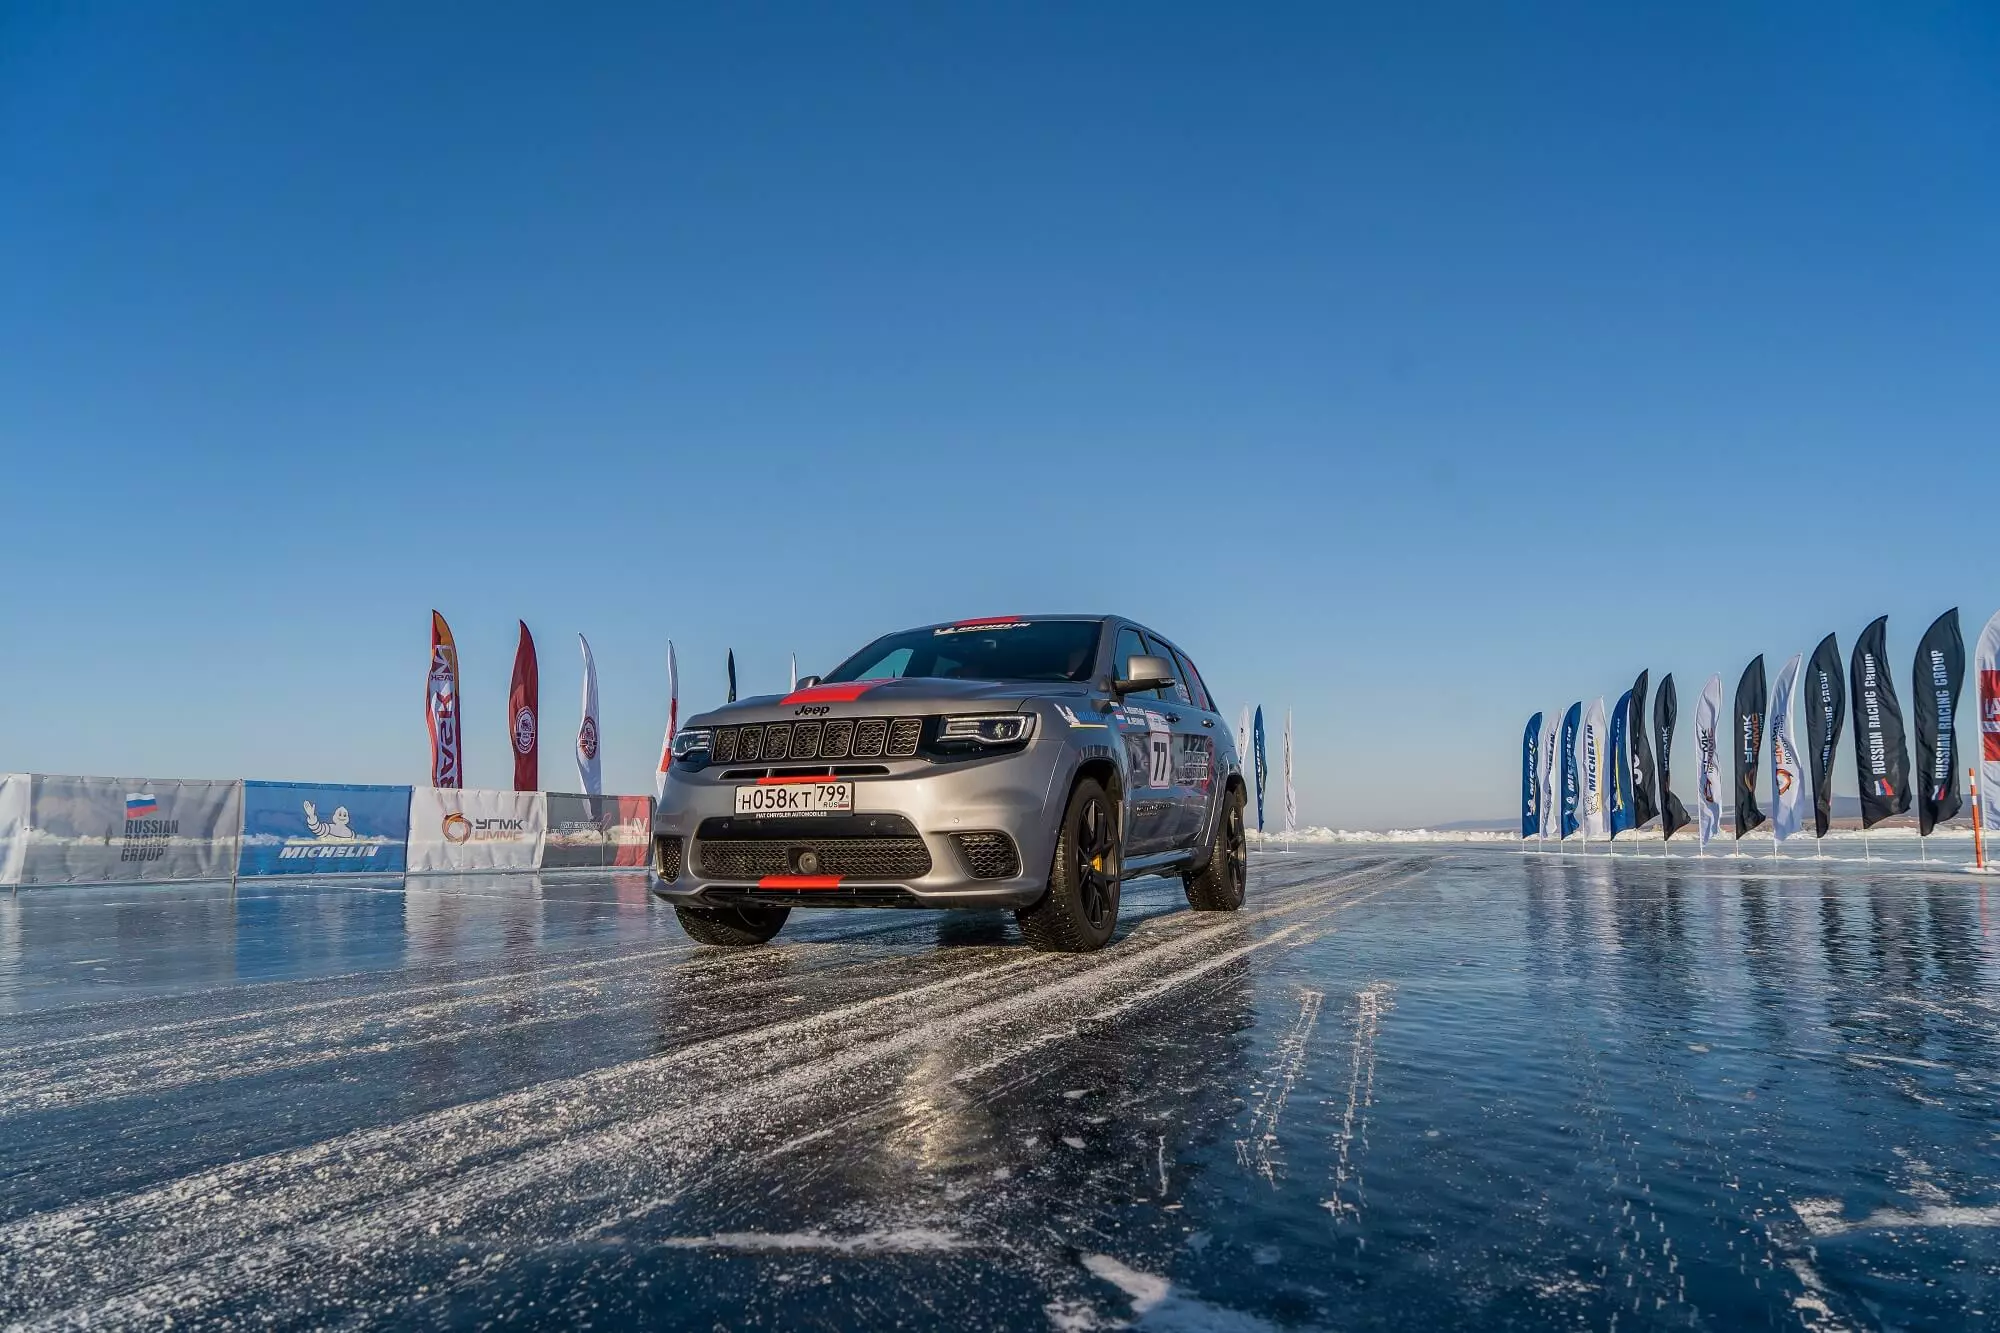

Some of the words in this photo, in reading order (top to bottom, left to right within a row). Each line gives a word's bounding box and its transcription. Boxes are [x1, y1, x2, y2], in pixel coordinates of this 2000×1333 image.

[1930, 649, 1949, 686] GROUP
[794, 704, 831, 717] Jeep
[1864, 690, 1881, 728] RACING
[1937, 690, 1952, 729] RACING
[1153, 741, 1167, 781] 77
[1587, 724, 1596, 792] MICHELIN
[1869, 731, 1886, 774] RUSSIAN
[1935, 733, 1952, 779] RUSSIAN
[816, 785, 846, 801] 799
[125, 819, 179, 833] RUSSIAN
[475, 830, 525, 841] UMMC
[476, 819, 523, 830] УГМК
[121, 847, 164, 862] GROUP
[279, 845, 379, 859] MICHELIN
